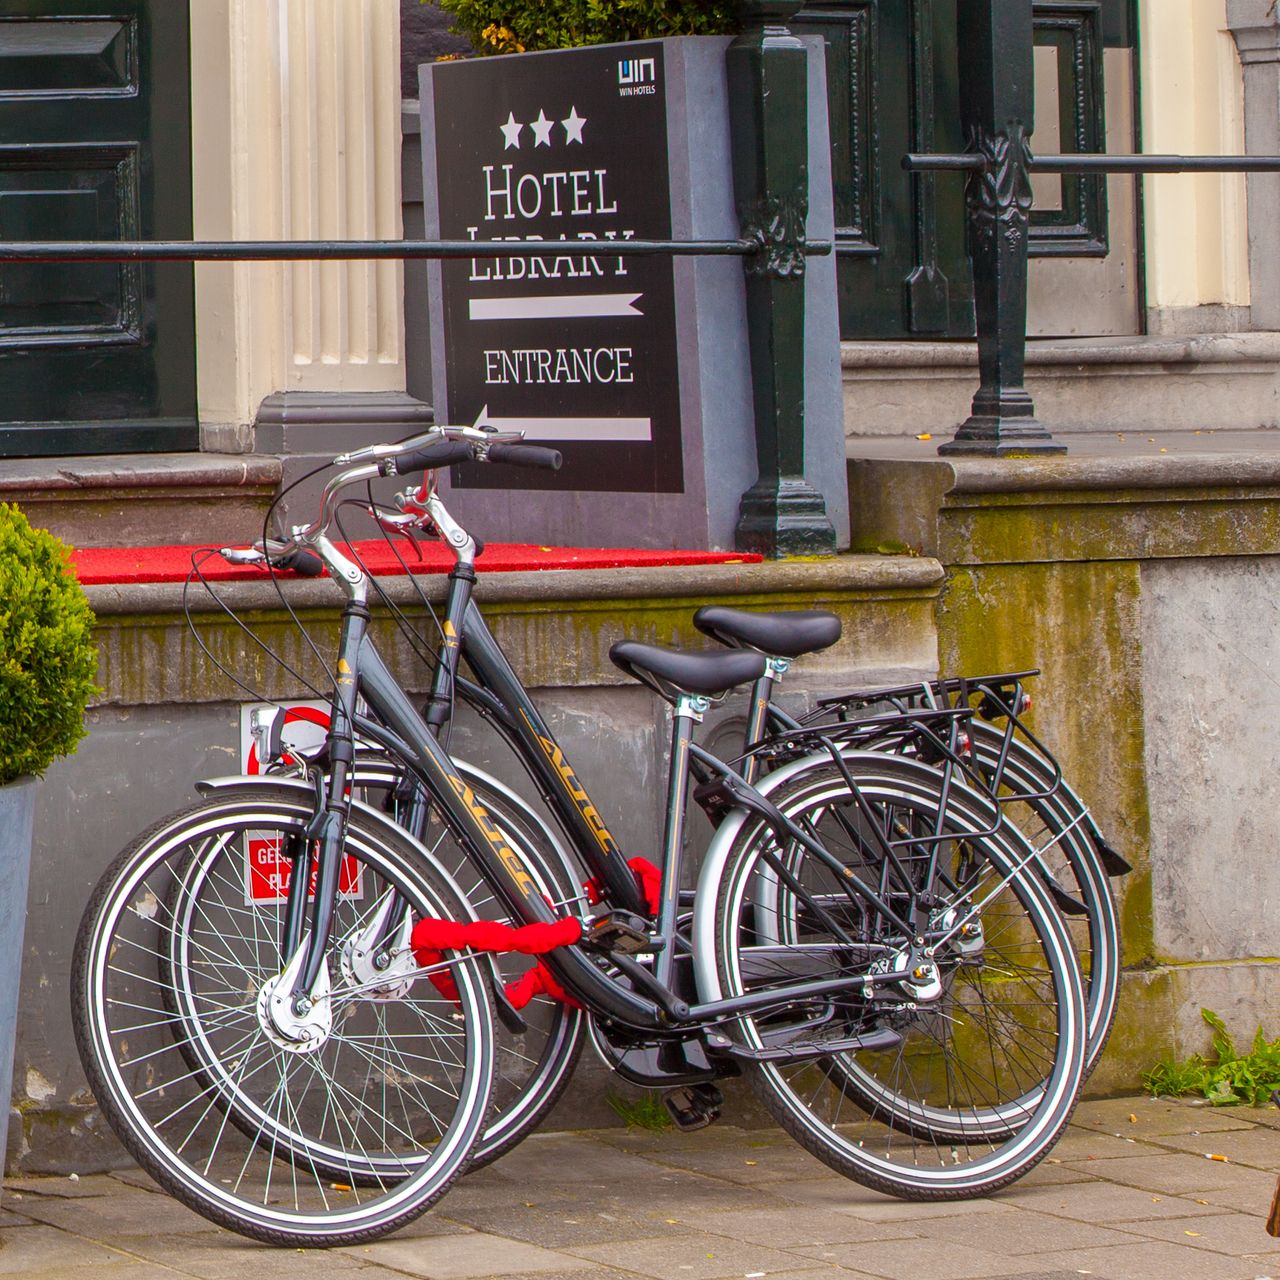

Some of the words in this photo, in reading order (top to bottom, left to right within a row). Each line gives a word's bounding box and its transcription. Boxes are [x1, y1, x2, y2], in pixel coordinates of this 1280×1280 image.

[619, 87, 633, 97] WIN
[633, 85, 656, 96] HOTELS
[482, 164, 618, 221] HOTEL
[483, 347, 634, 384] ENTRANCE
